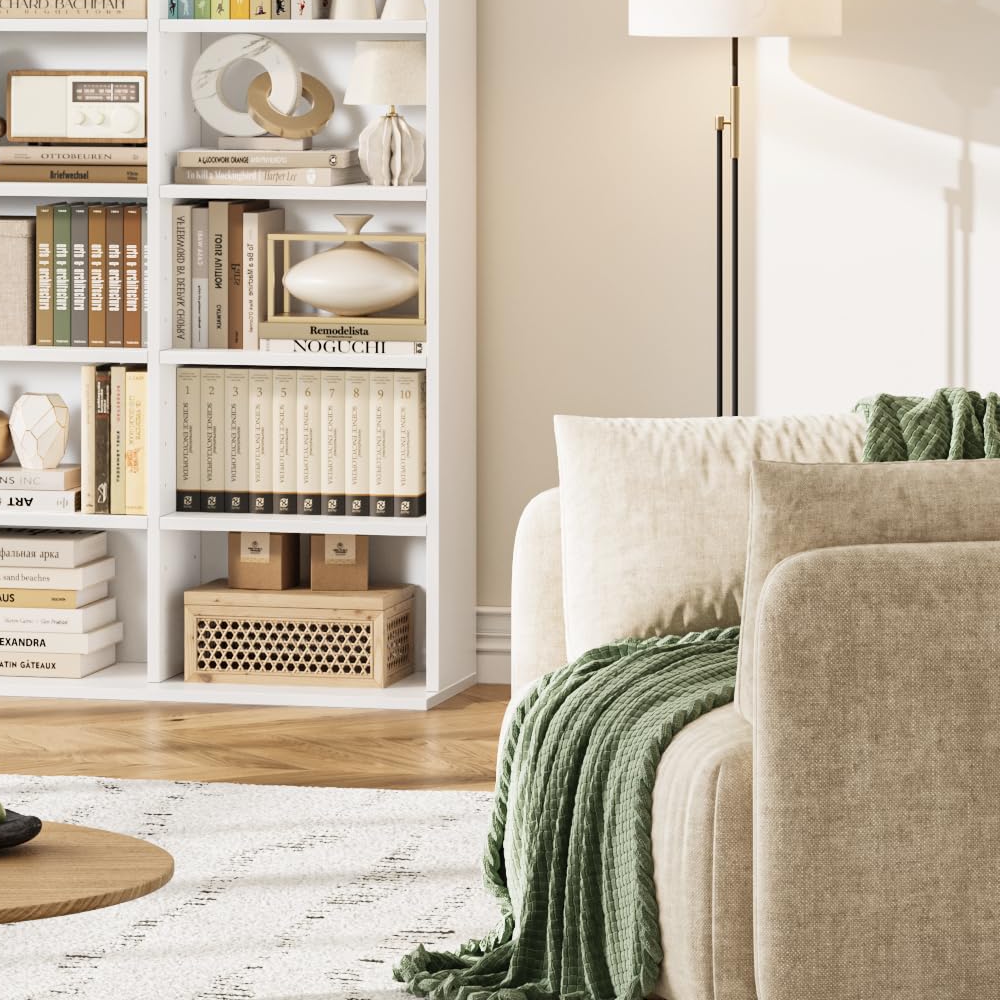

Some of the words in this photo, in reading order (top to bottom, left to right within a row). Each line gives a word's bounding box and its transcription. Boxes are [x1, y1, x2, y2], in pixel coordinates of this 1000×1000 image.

[50, 170, 89, 179] Briefwechsel
[264, 170, 285, 182] Harper
[310, 326, 369, 336] Remodelista
[293, 340, 386, 354] NOGUCHI
[185, 386, 190, 395] 1
[209, 386, 214, 395] 2
[233, 386, 238, 397] 3
[280, 387, 287, 397] 5
[305, 387, 311, 396] 6
[329, 388, 335, 398] 7
[353, 388, 359, 397] 8
[378, 389, 384, 399] 9
[400, 389, 411, 399] 10
[19, 475, 40, 485] INC
[7, 498, 34, 506] ART
[39, 551, 59, 560] арка
[3, 573, 20, 582] sand
[21, 573, 50, 582] beaches
